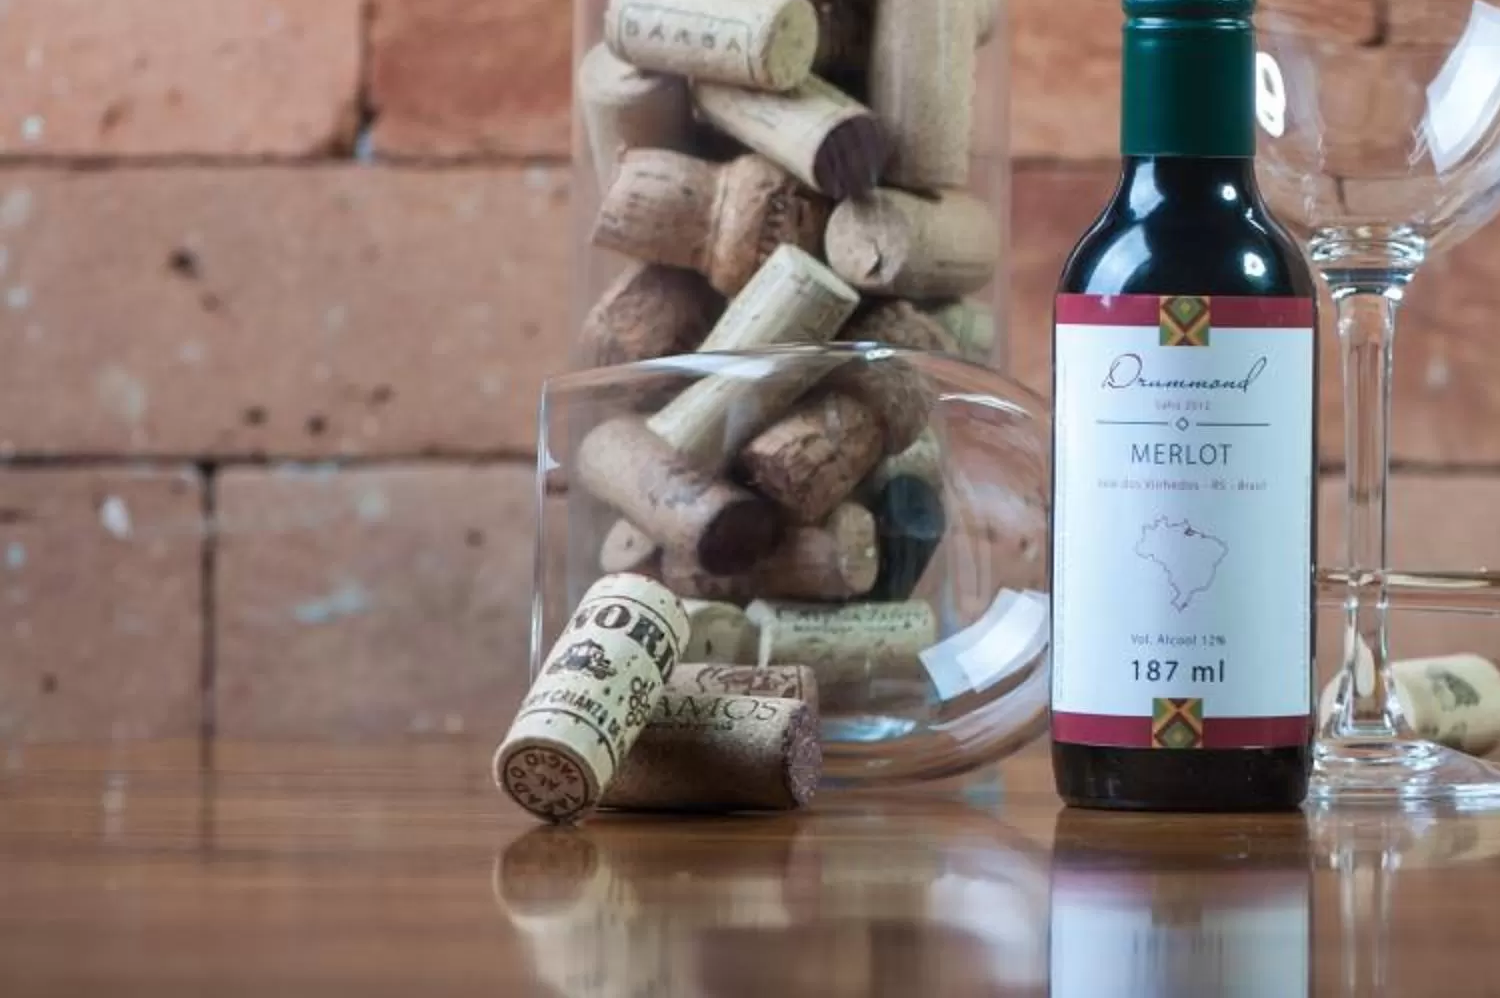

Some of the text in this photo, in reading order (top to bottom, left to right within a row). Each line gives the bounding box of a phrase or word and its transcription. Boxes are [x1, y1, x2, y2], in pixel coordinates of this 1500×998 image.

[1101, 353, 1268, 393] Drummond
[1131, 443, 1233, 466] MERLOT
[1131, 658, 1225, 683] 187 ml
